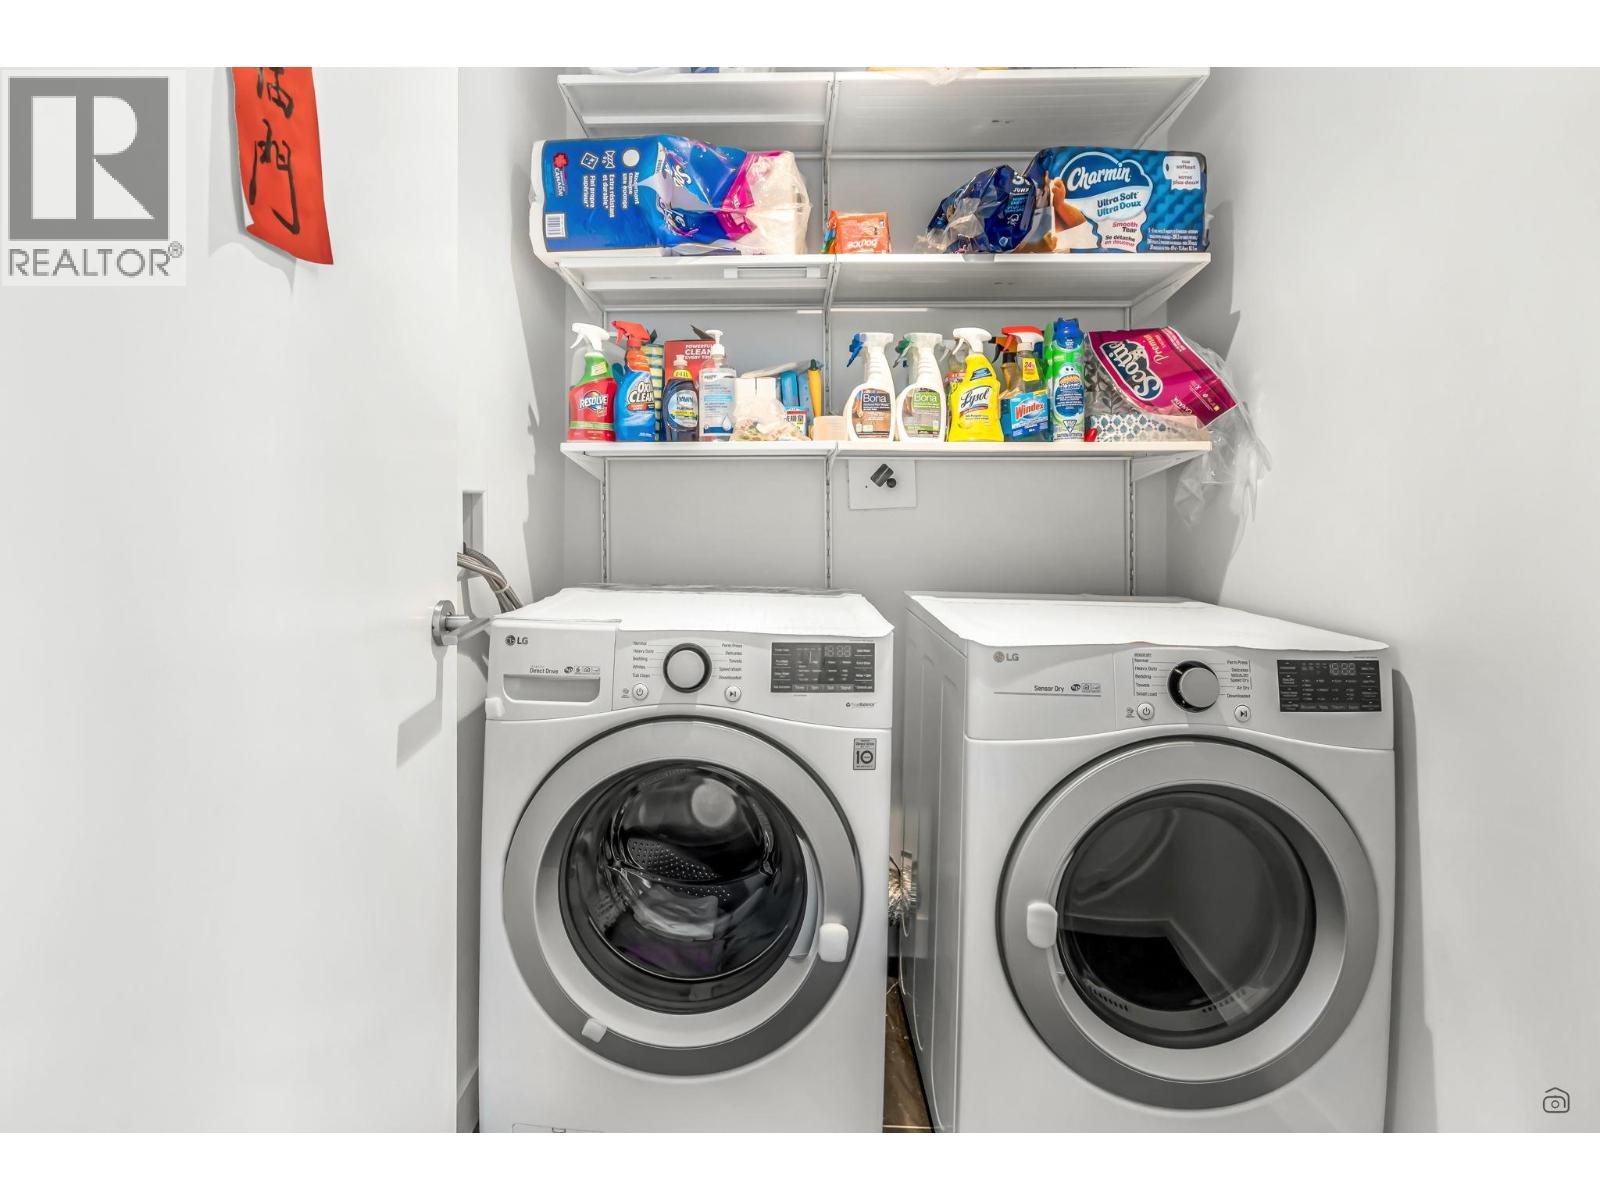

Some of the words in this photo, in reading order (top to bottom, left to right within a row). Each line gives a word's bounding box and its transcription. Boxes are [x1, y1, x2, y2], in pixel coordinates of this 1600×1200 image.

[1067, 166, 1131, 191] Charmin
[1097, 195, 1119, 208] Ultra
[1120, 192, 1138, 201] Soft
[1097, 206, 1119, 217] Ultra
[1120, 200, 1141, 210] Doux
[580, 395, 608, 408] RESOLVE
[629, 391, 654, 403] CLEAN
[863, 393, 886, 402] Bona
[914, 392, 937, 402] Bona
[961, 387, 990, 408] Lysol
[1015, 402, 1043, 420] Windex
[1055, 685, 1064, 693] Dry
